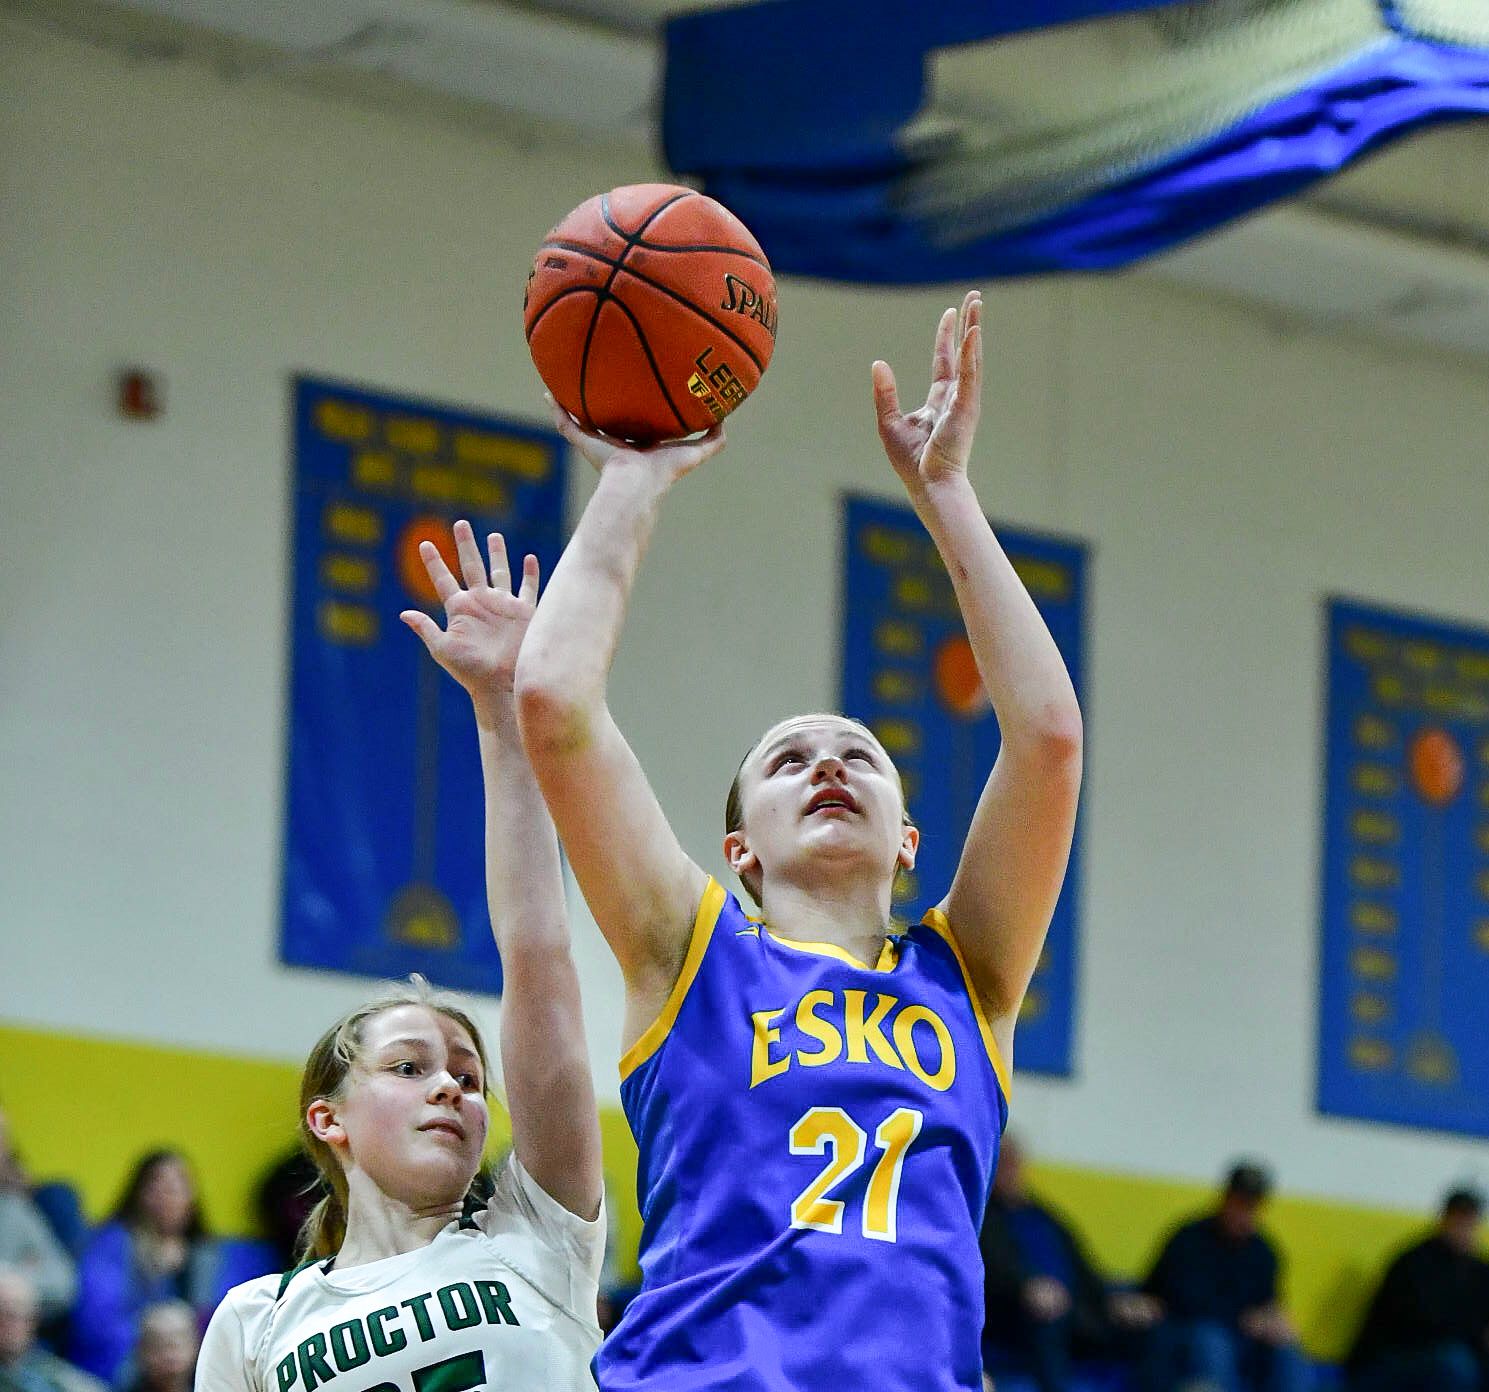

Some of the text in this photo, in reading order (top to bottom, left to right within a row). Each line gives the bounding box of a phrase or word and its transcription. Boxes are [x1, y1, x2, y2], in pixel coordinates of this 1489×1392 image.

[721, 273, 773, 331] SPAL
[750, 989, 956, 1092] ESKO
[789, 1107, 923, 1243] 21
